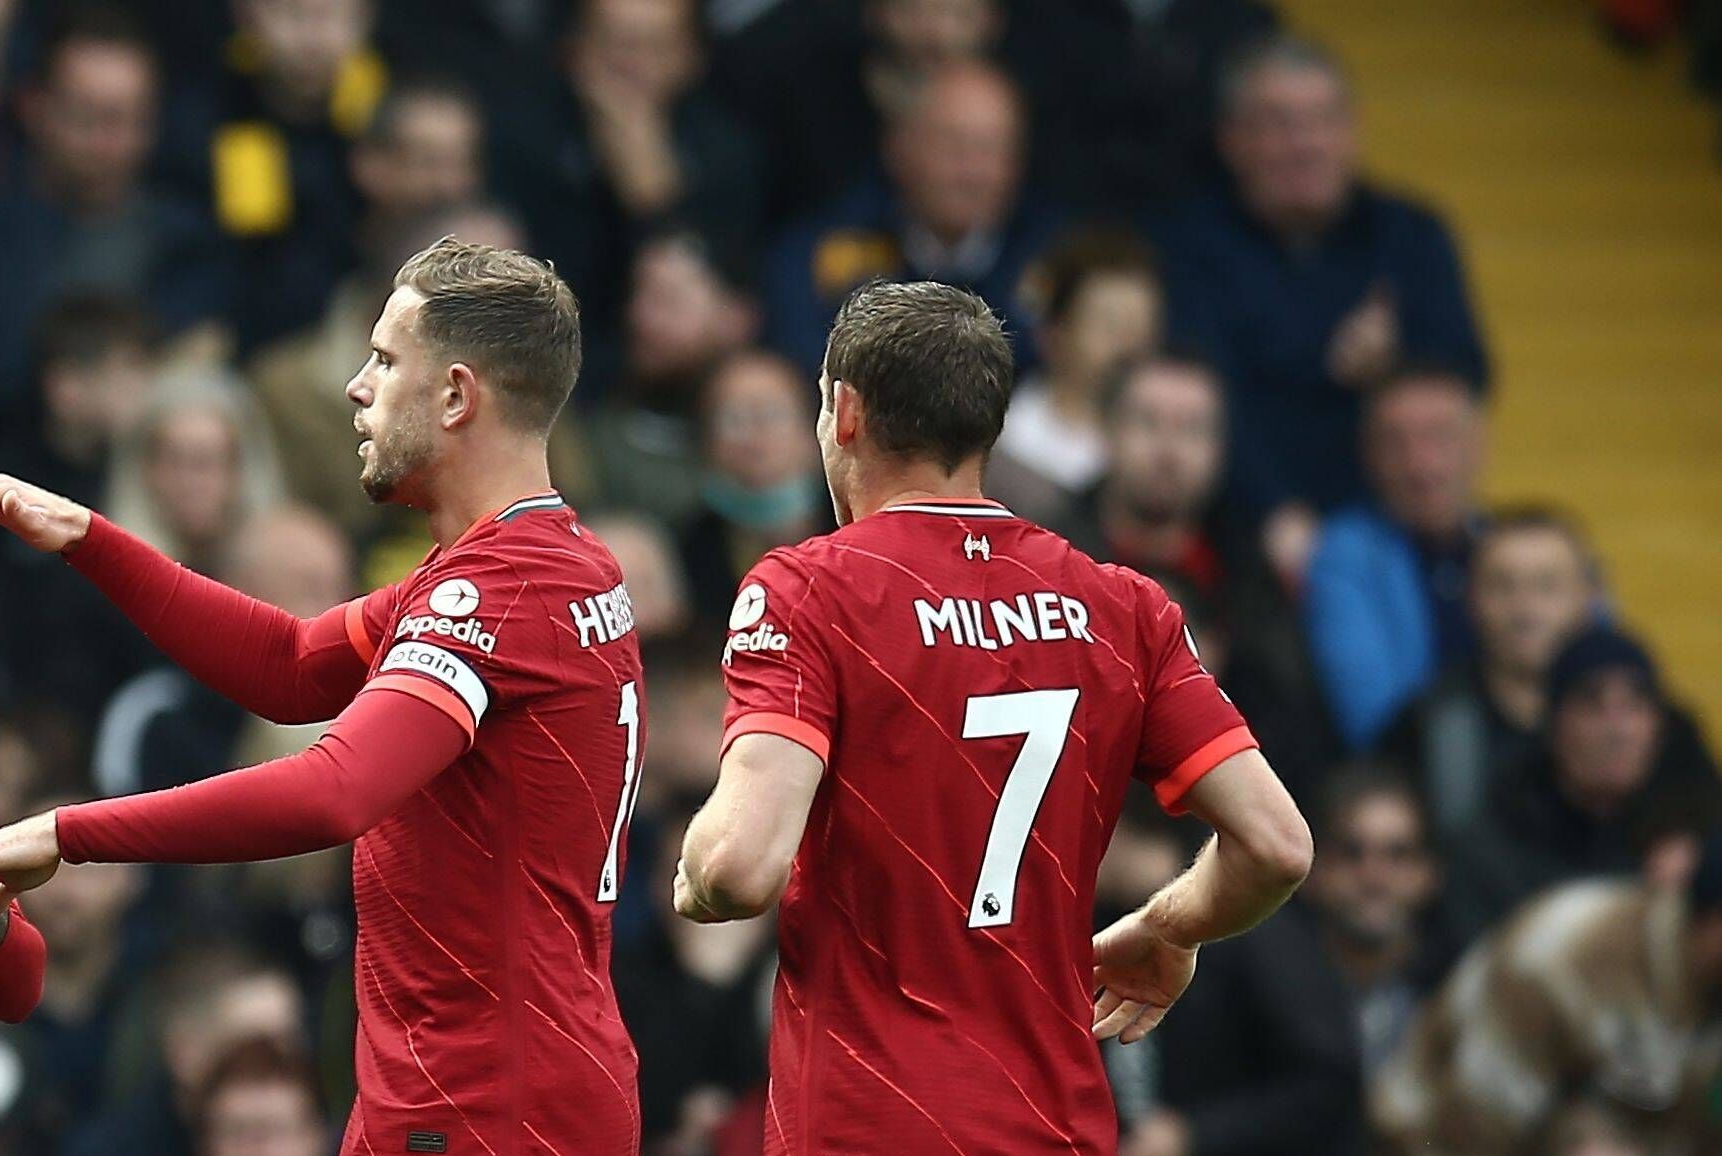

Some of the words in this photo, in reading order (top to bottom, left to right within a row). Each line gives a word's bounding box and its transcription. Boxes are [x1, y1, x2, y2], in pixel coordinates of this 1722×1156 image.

[913, 592, 1094, 650] MILNER
[598, 681, 644, 902] 1
[962, 688, 1080, 928] 7
